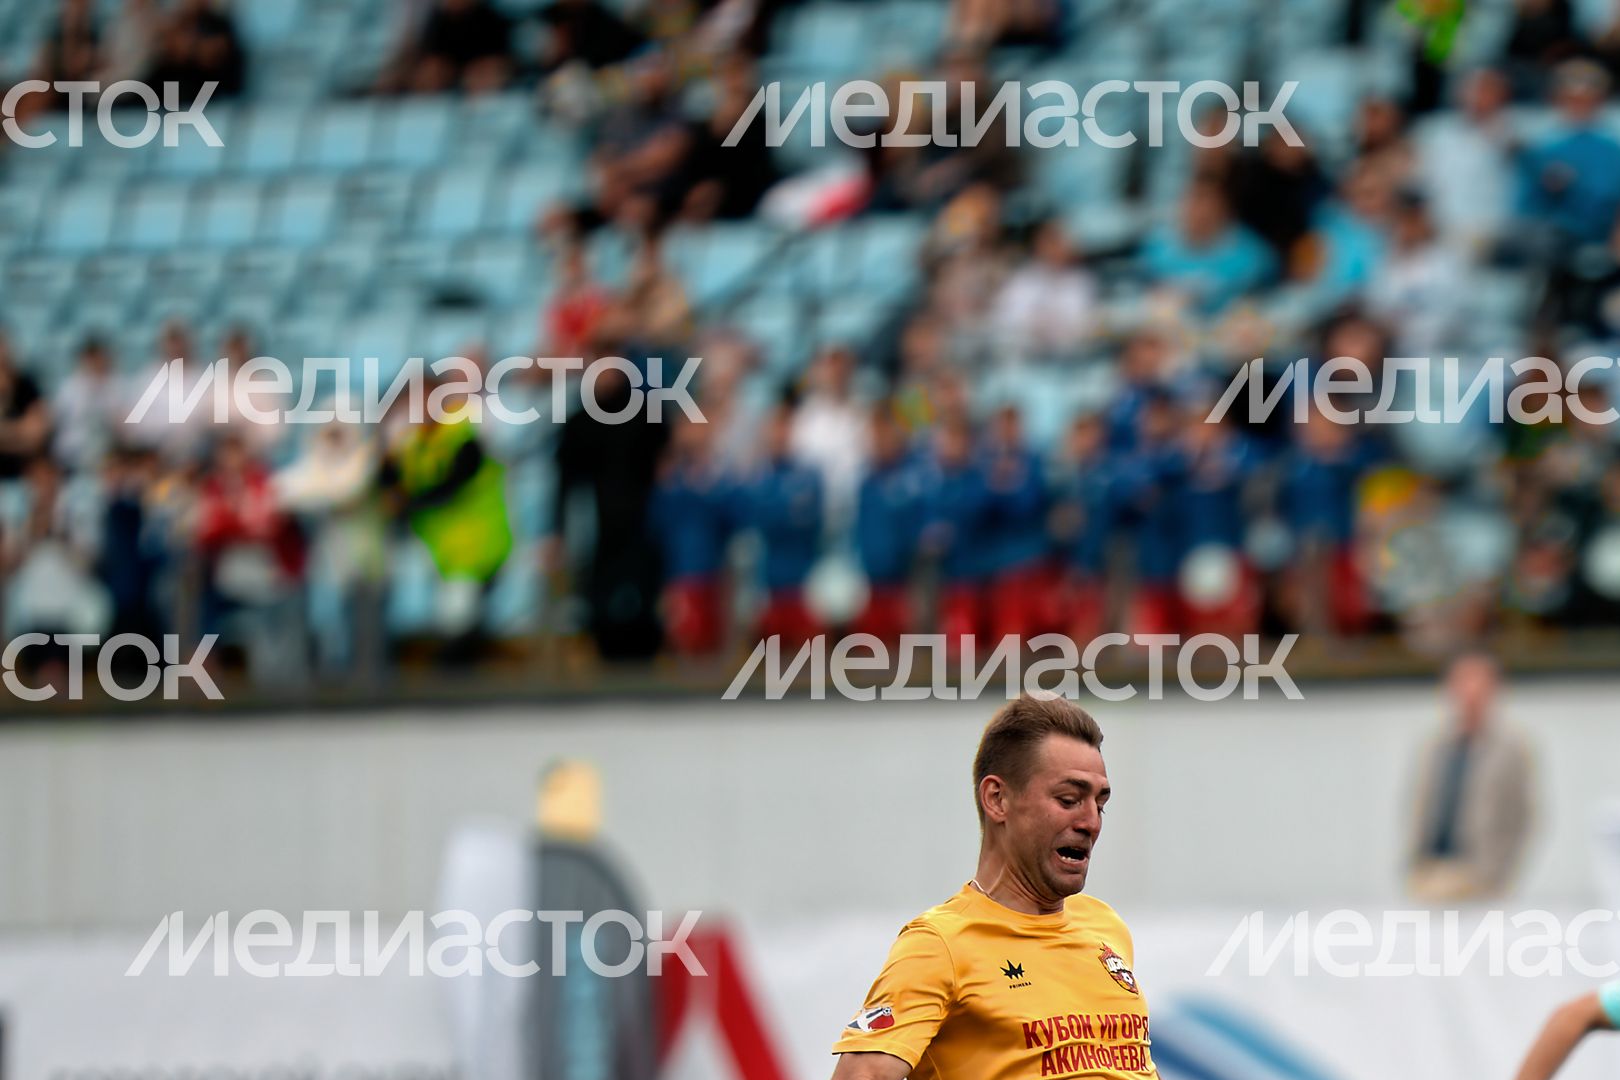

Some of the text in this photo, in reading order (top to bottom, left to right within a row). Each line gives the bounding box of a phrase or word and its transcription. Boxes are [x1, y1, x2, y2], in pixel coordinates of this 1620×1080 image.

[1022, 1013, 1150, 1049] КУБОК ИГОРЯ
[1041, 1045, 1150, 1077] АКИНФЕЕВА
